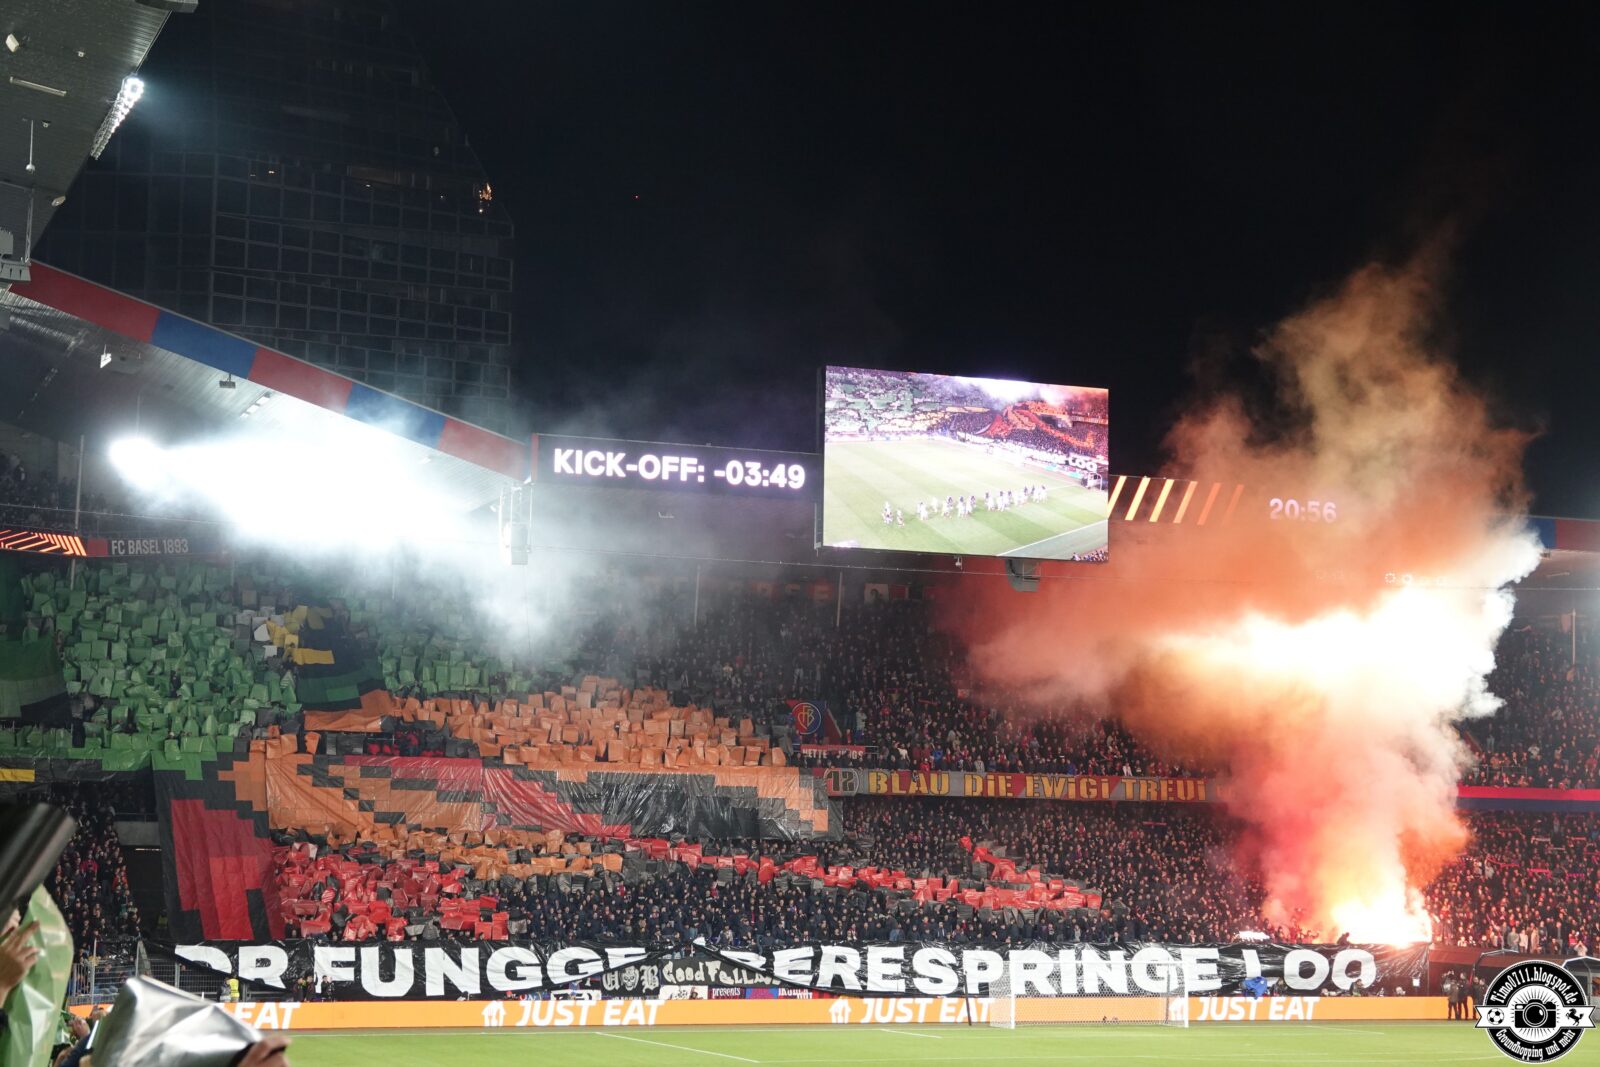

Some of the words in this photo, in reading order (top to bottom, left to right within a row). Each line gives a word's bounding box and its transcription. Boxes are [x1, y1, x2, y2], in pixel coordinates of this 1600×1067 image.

[553, 448, 705, 483] KICK-OFF:
[713, 459, 806, 490] -03:49
[1269, 497, 1337, 524] 20:56
[111, 539, 126, 555] FC
[127, 539, 161, 555] BASEL
[162, 538, 189, 554] 1893
[868, 771, 950, 795] BLAU
[515, 1000, 598, 1027] JUST
[603, 1000, 665, 1026] EAT
[860, 998, 935, 1024] JUST
[939, 998, 996, 1023] EAT
[1197, 998, 1263, 1020] JUST
[1268, 997, 1320, 1020] EAT
